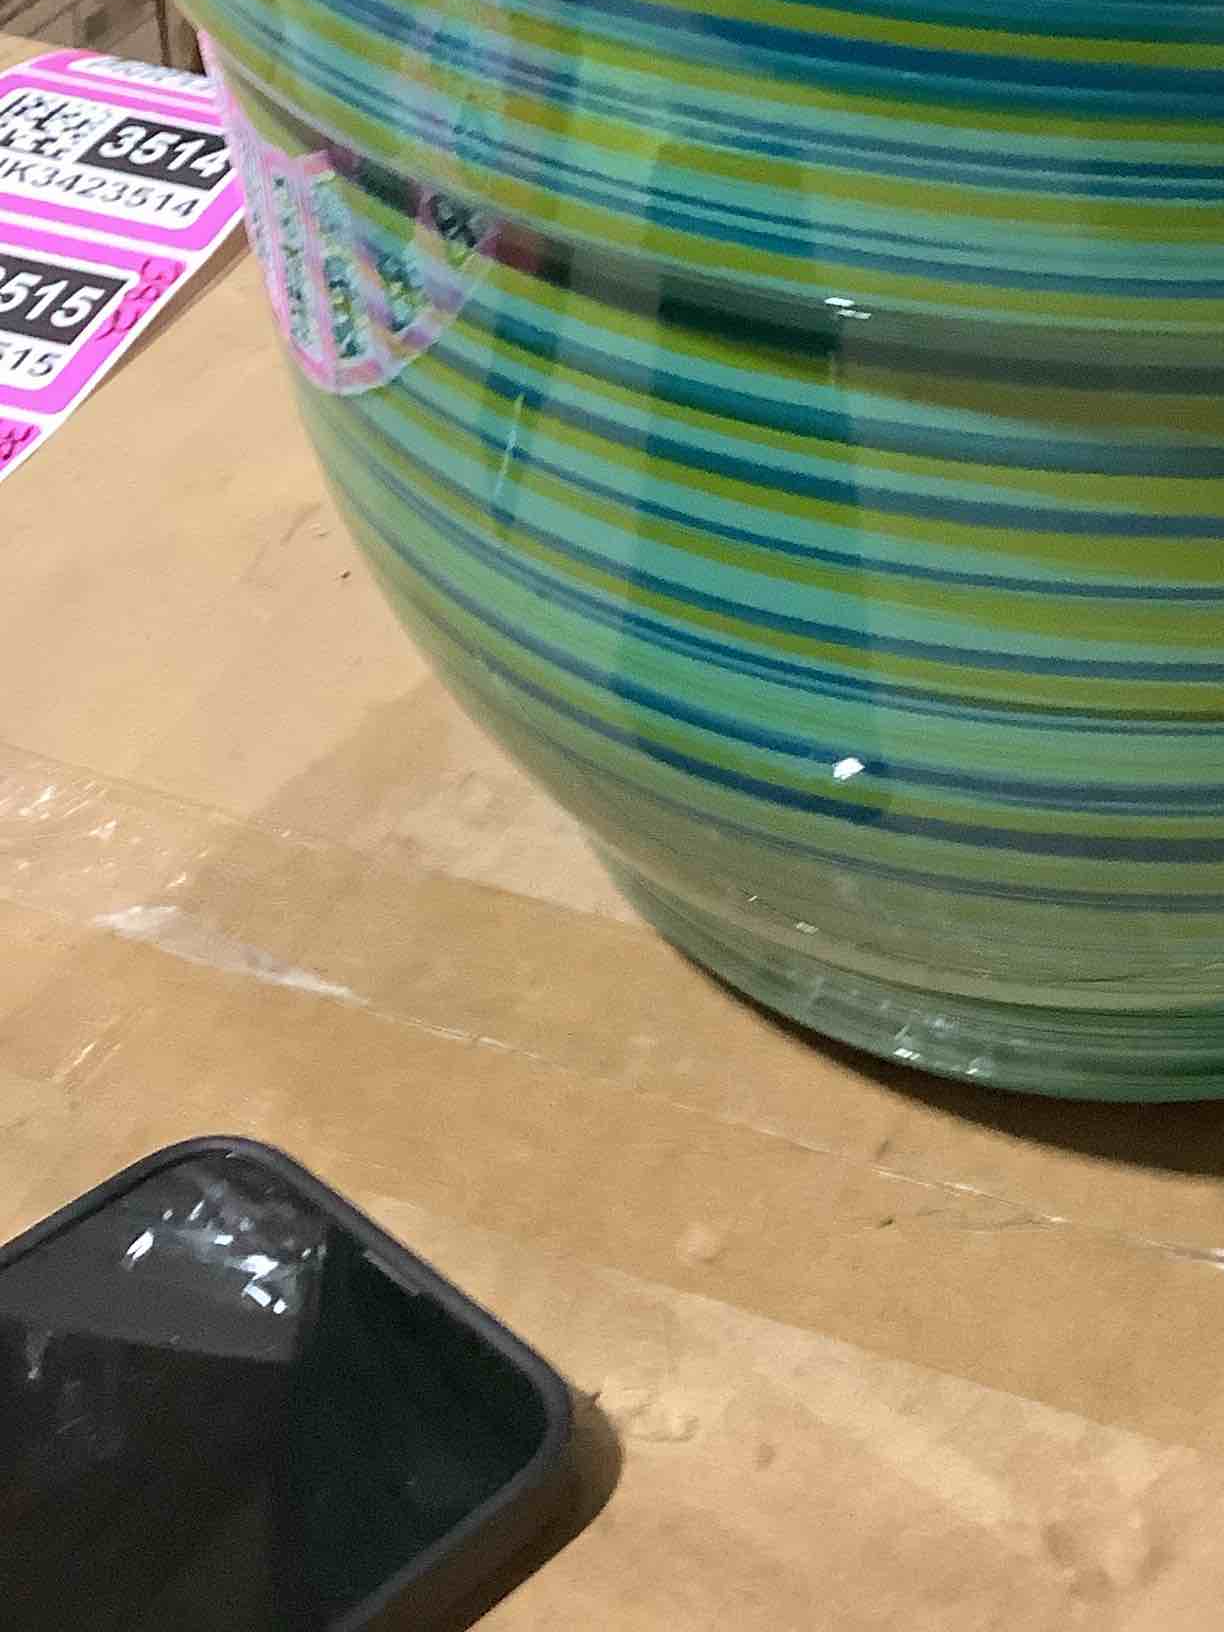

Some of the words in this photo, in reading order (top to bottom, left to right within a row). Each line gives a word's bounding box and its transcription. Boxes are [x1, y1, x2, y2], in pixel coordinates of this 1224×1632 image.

[99, 124, 232, 178] 3514
[0, 157, 200, 217] K3423514
[0, 264, 105, 328] 515
